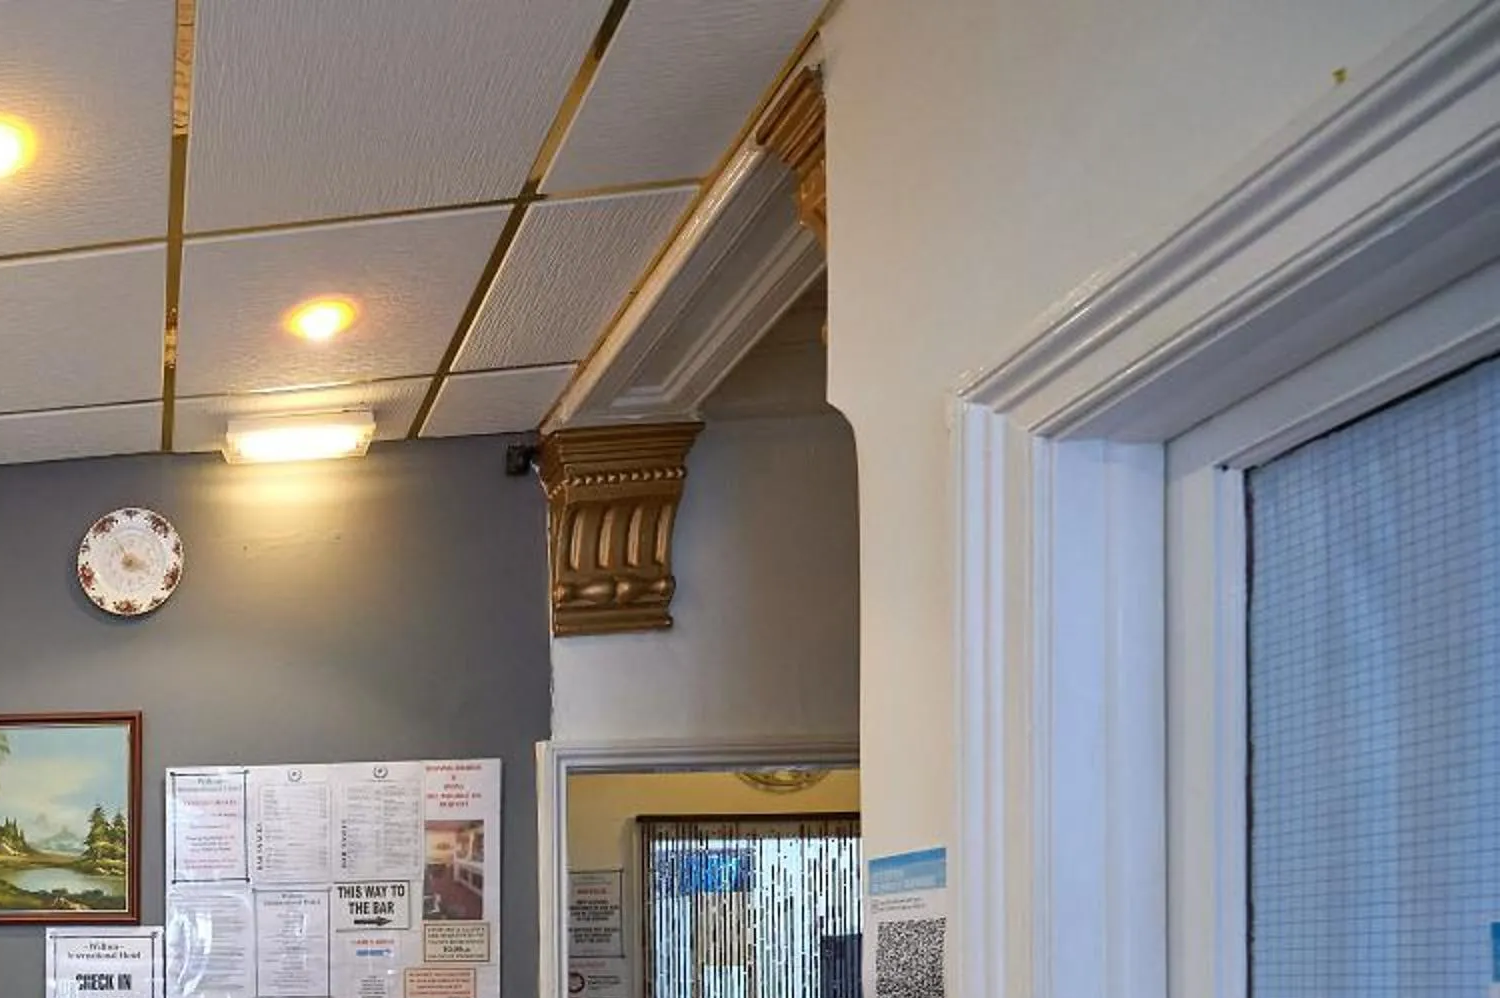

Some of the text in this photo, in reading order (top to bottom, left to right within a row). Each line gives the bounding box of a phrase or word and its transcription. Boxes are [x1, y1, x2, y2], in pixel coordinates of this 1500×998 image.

[338, 884, 405, 898] THIS WAY TO
[348, 901, 395, 915] THE BAR
[75, 973, 131, 991] CHECK IN
